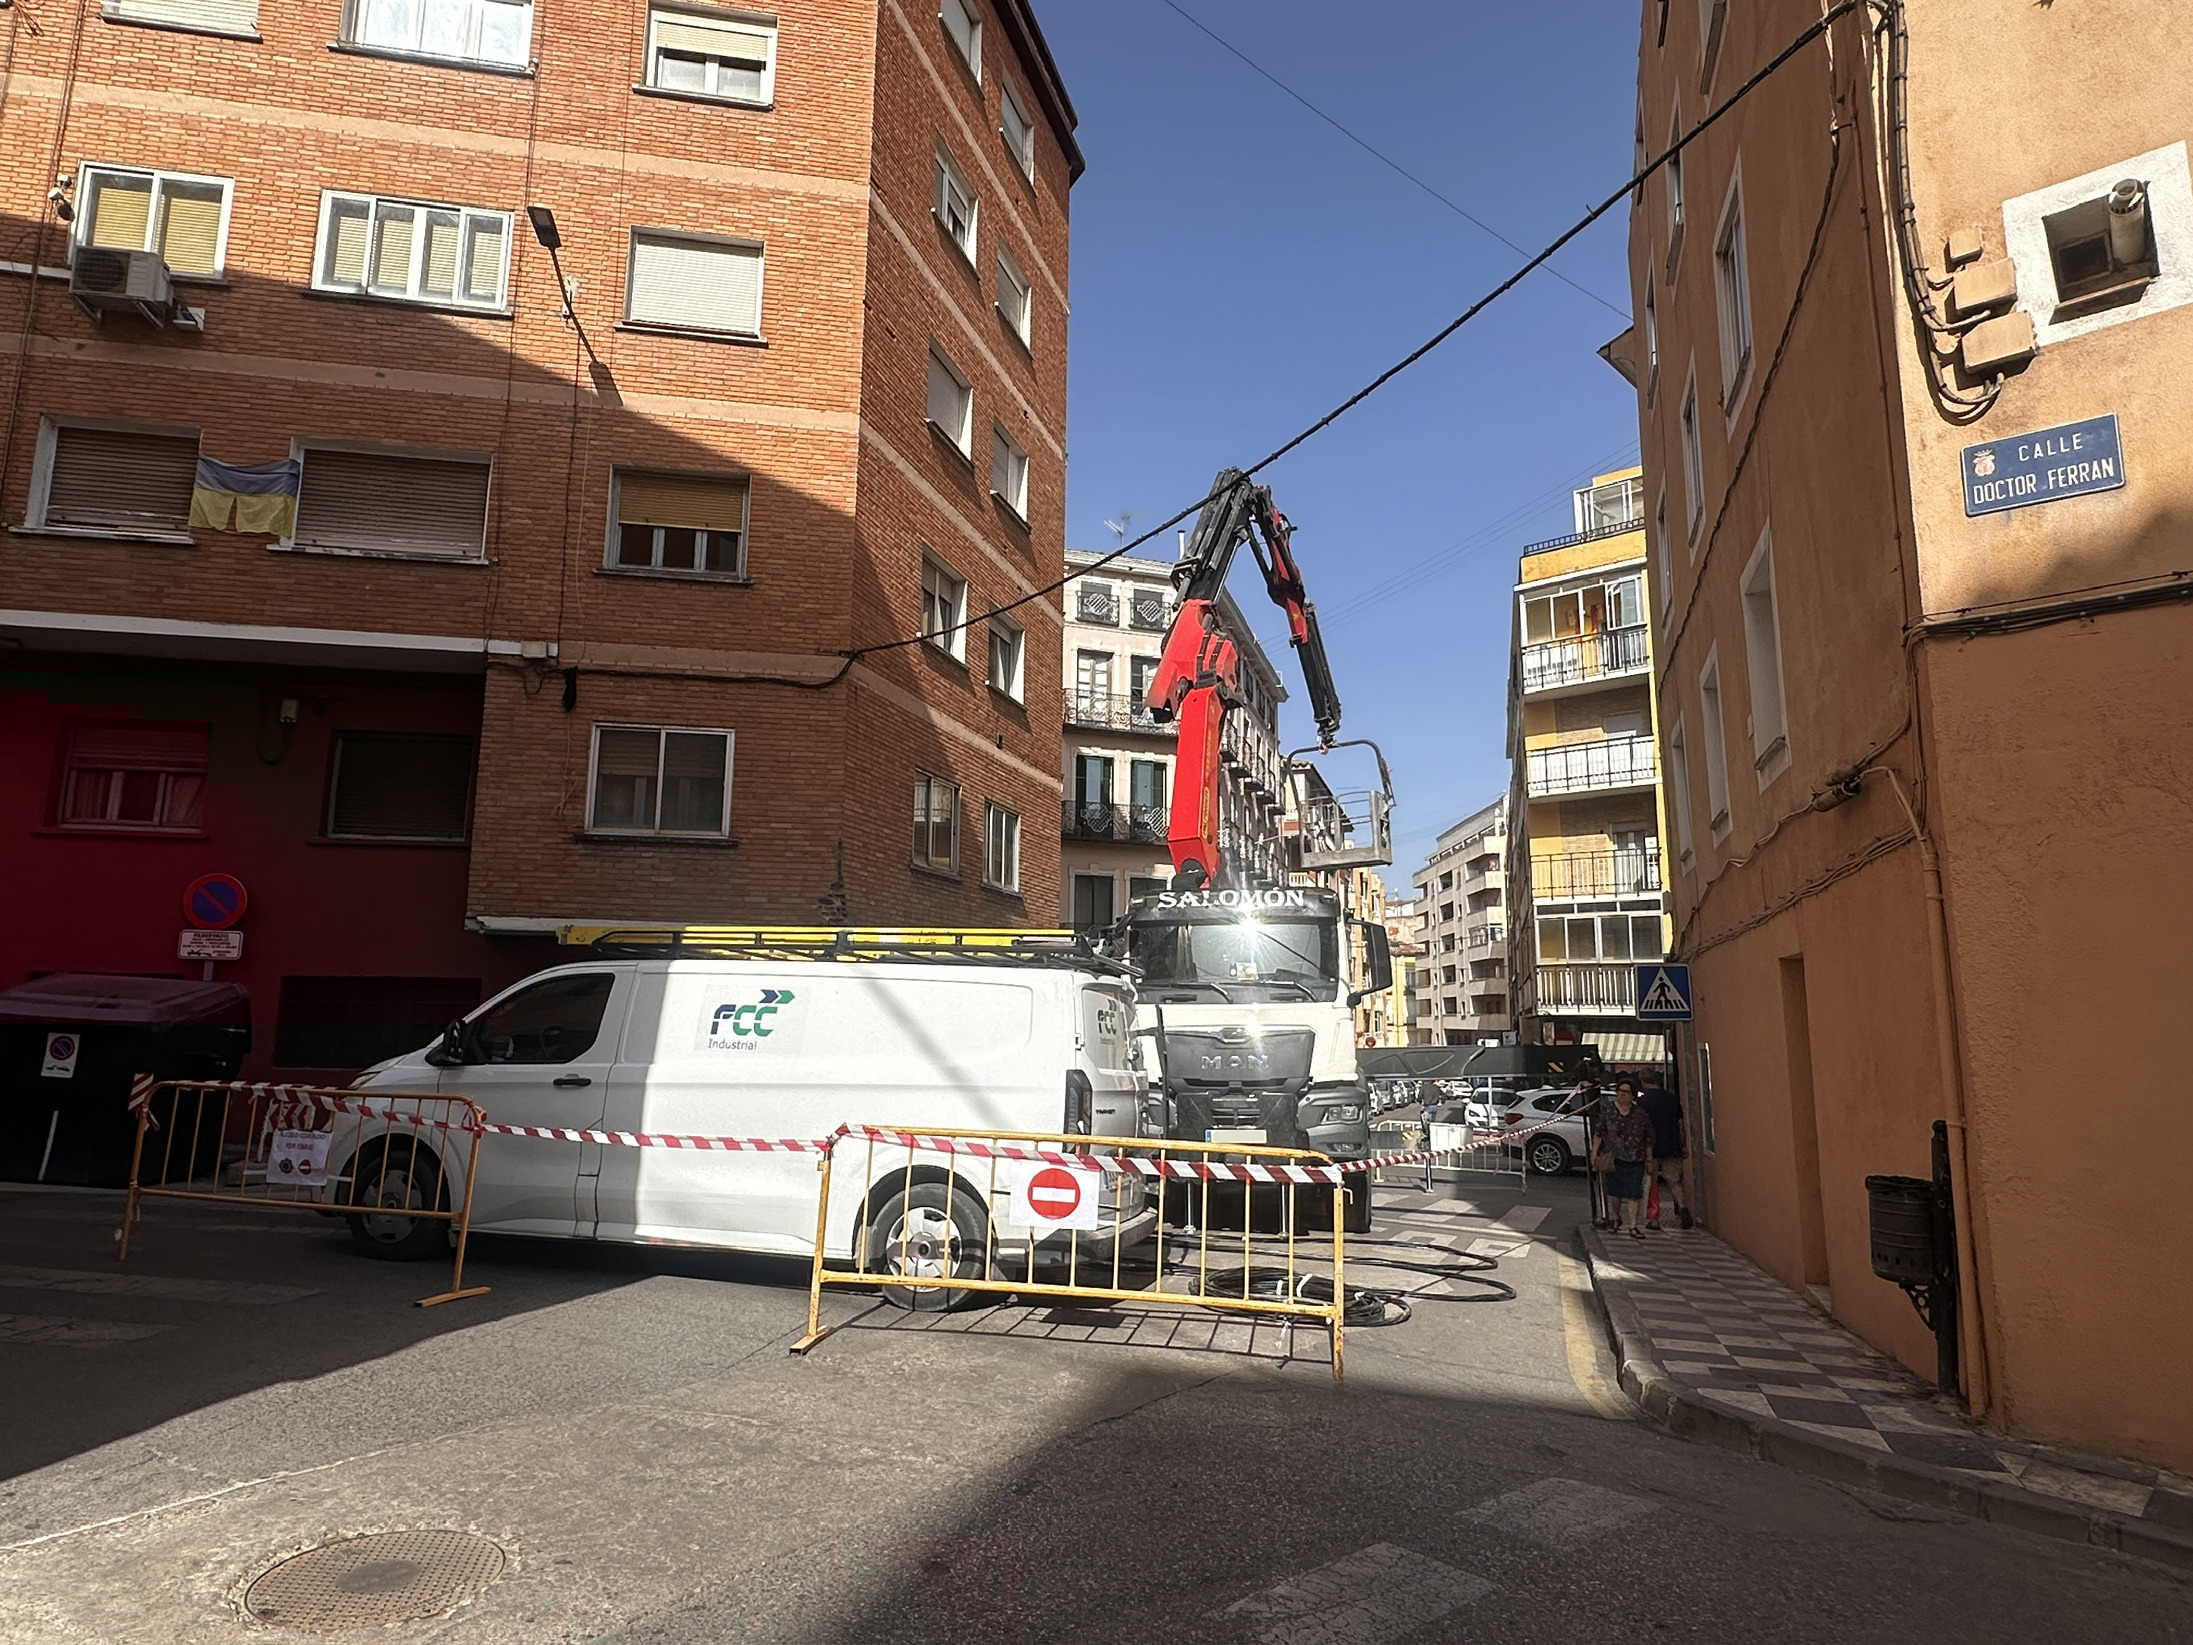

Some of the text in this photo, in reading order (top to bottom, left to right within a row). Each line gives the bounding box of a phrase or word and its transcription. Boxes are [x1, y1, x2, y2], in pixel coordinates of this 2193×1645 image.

[2018, 432, 2084, 462] CALLE
[1973, 456, 2115, 505] DOCTOR FERRAN
[1157, 887, 1305, 909] SALOMÓN
[710, 1004, 778, 1037] FCC
[1097, 1009, 1117, 1035] FCC
[708, 1038, 757, 1051] Industrial
[1201, 1055, 1269, 1070] MAN
